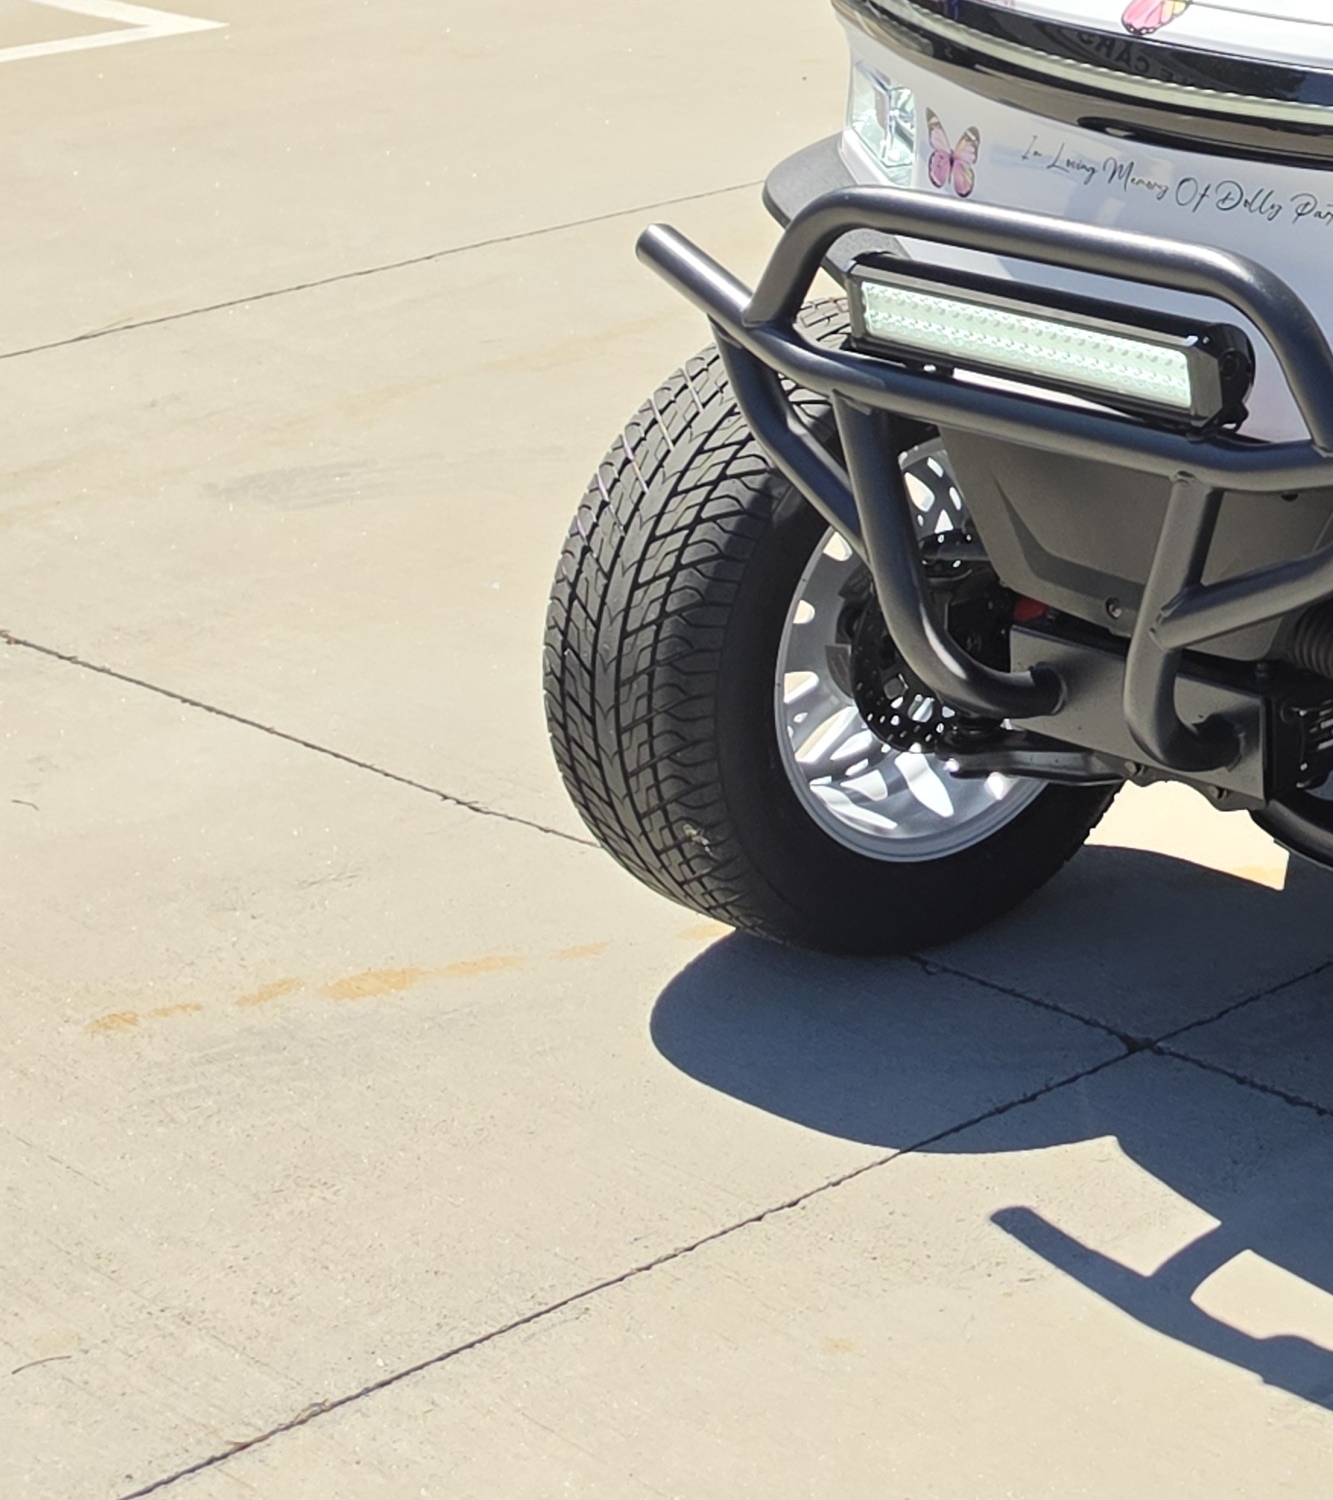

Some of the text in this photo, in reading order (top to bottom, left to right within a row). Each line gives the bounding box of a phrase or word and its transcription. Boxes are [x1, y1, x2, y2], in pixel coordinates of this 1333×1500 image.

[1046, 142, 1098, 185] Loving
[1102, 156, 1170, 200] Memory
[1175, 176, 1212, 213] Of
[1215, 179, 1283, 222] Dolly
